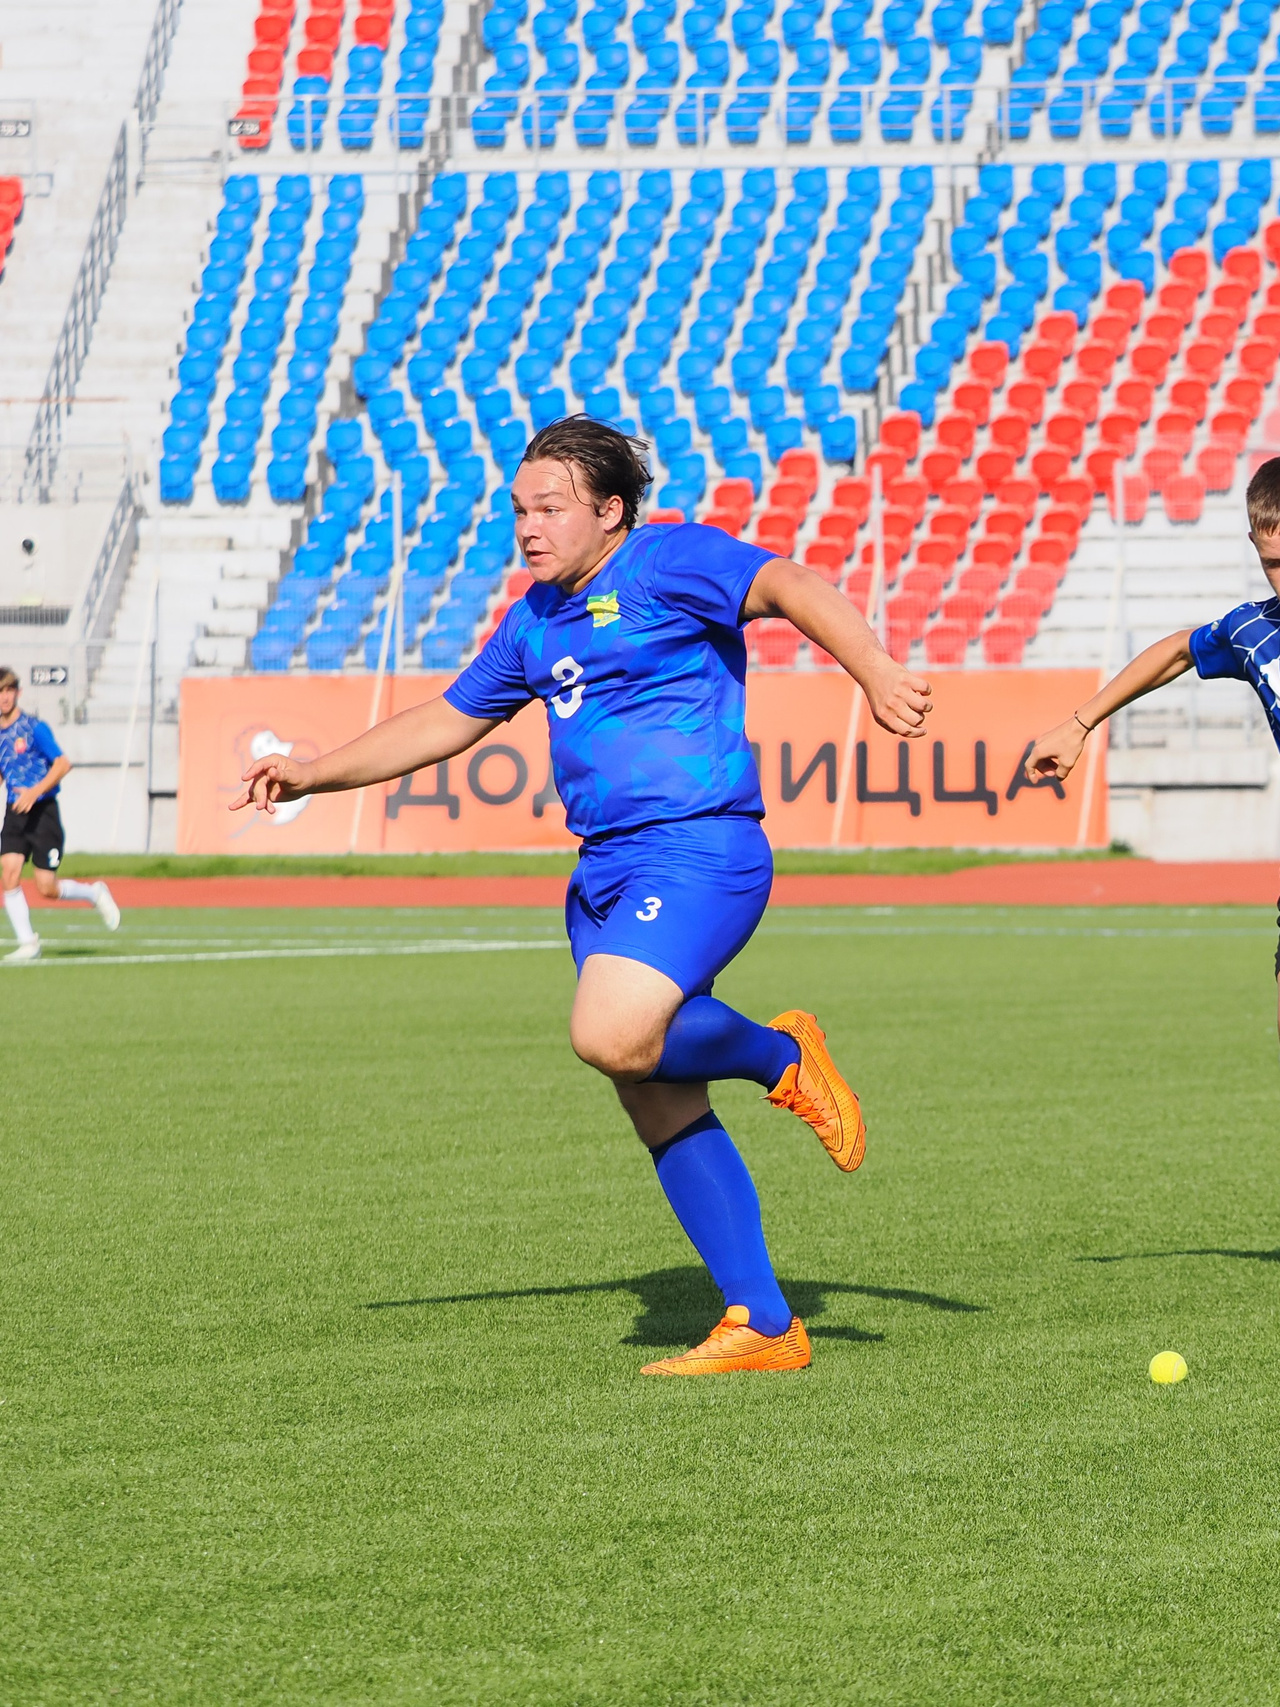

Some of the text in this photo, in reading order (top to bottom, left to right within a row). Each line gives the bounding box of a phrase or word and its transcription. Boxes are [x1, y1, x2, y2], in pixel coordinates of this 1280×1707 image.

[551, 655, 586, 719] 3
[386, 741, 1066, 820] ДО ИЦЦА
[635, 896, 662, 922] 3
